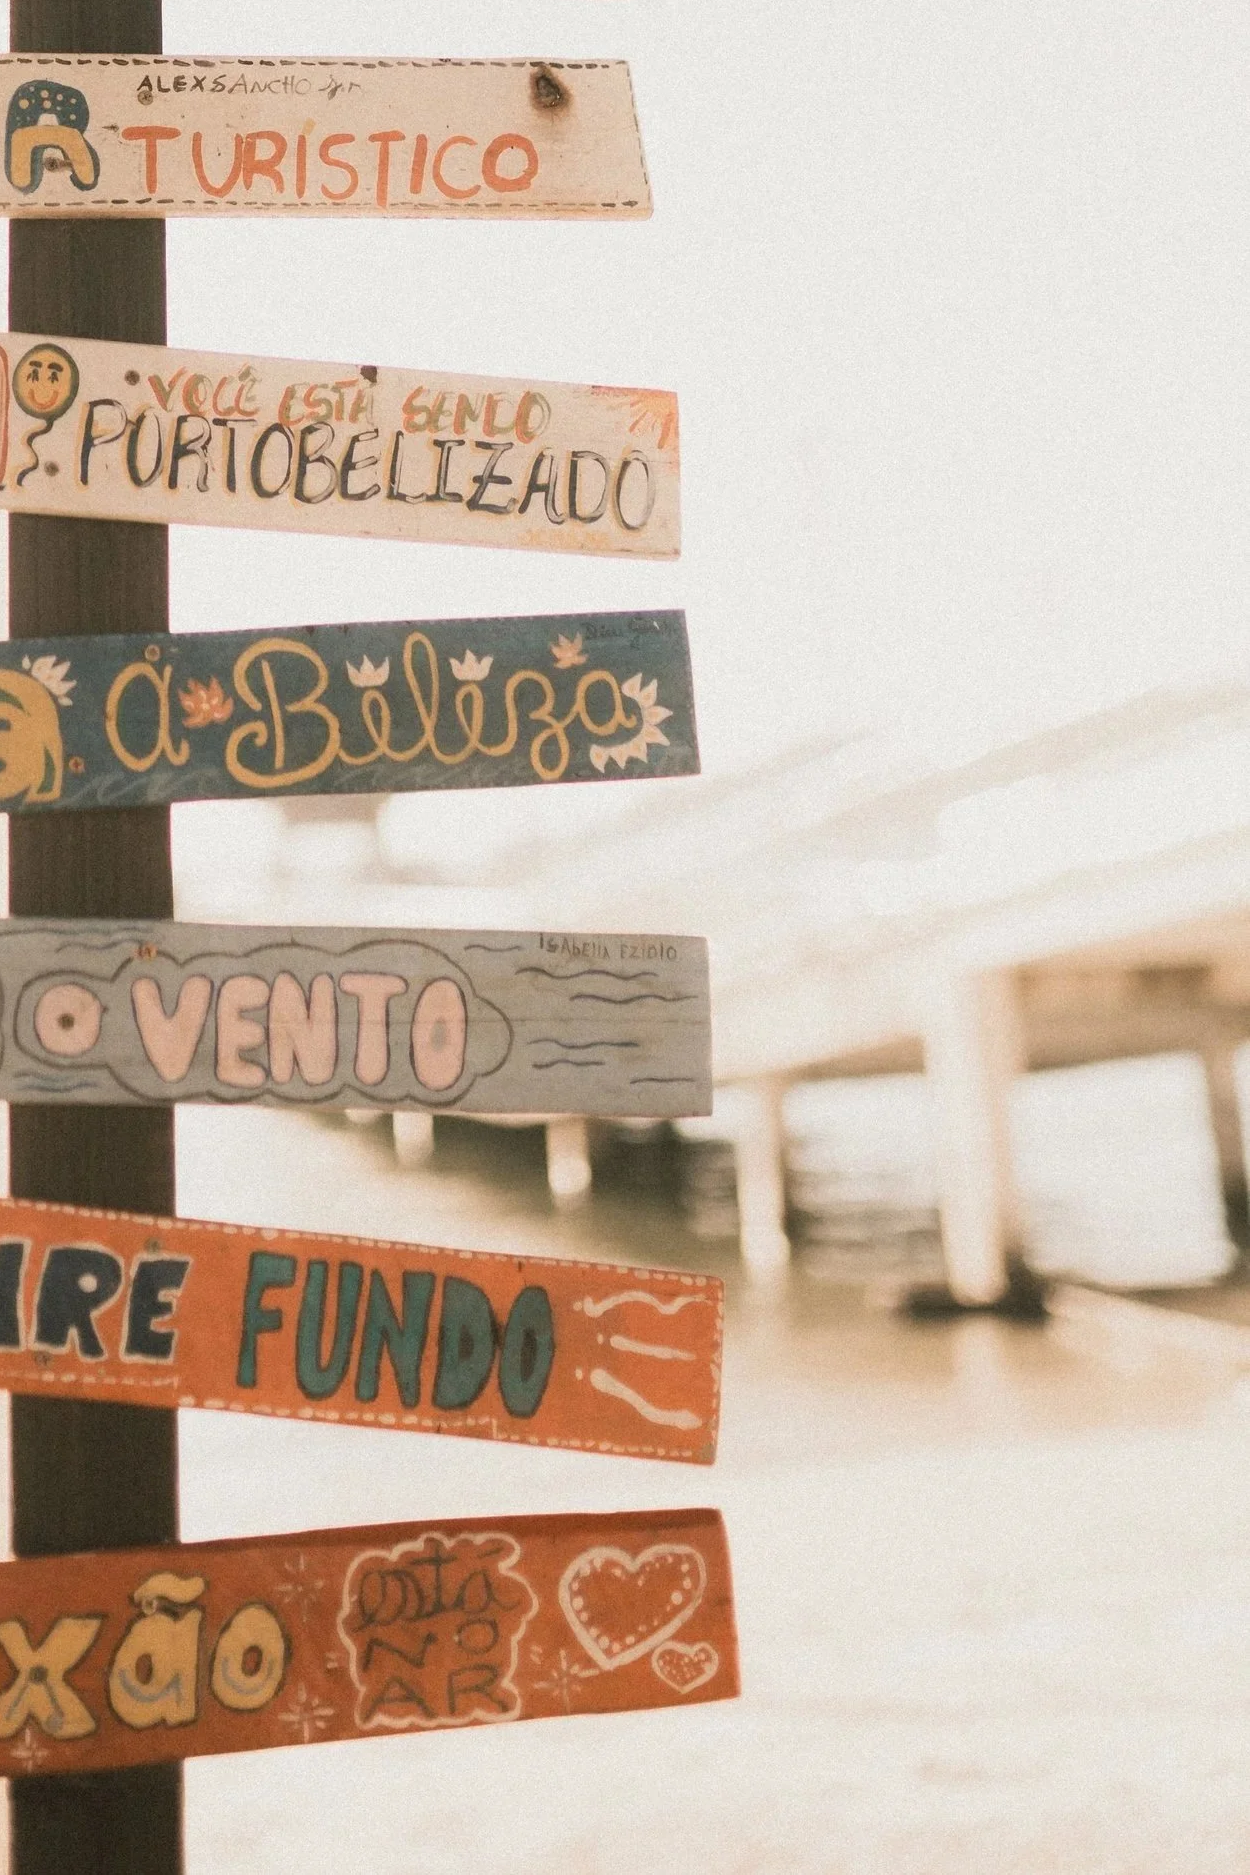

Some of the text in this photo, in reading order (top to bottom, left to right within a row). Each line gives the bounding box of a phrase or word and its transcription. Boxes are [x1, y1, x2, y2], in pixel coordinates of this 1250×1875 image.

[121, 119, 539, 209] TURÍSTICO
[78, 398, 657, 531] PORTOBELIZADO
[225, 632, 637, 788] Beleza
[34, 982, 102, 1056] O
[131, 971, 467, 1092] VENTO
[237, 1251, 556, 1418] FUNDO
